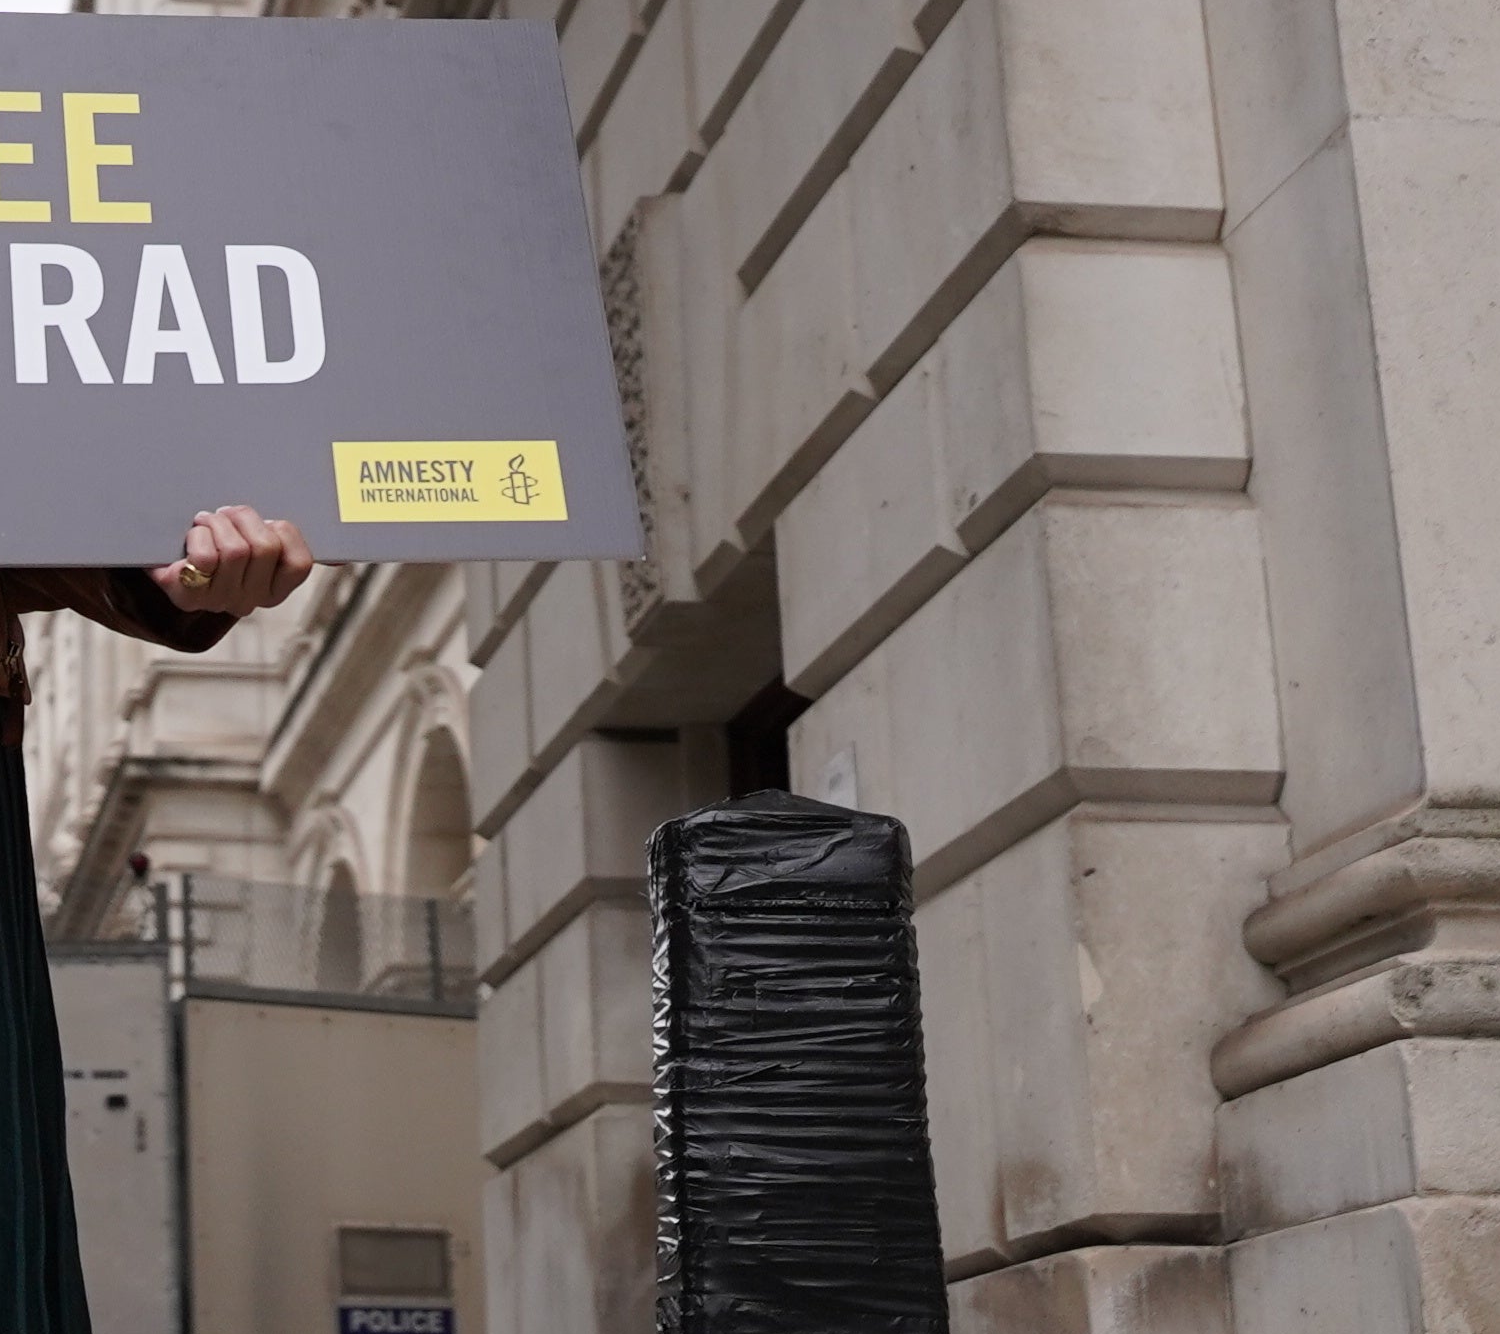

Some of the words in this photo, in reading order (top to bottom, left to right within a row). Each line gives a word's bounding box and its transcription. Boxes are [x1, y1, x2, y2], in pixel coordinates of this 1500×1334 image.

[359, 459, 474, 484] AMNESTY
[360, 487, 480, 503] INTERNATIONAL
[348, 1310, 444, 1333] POLICE
